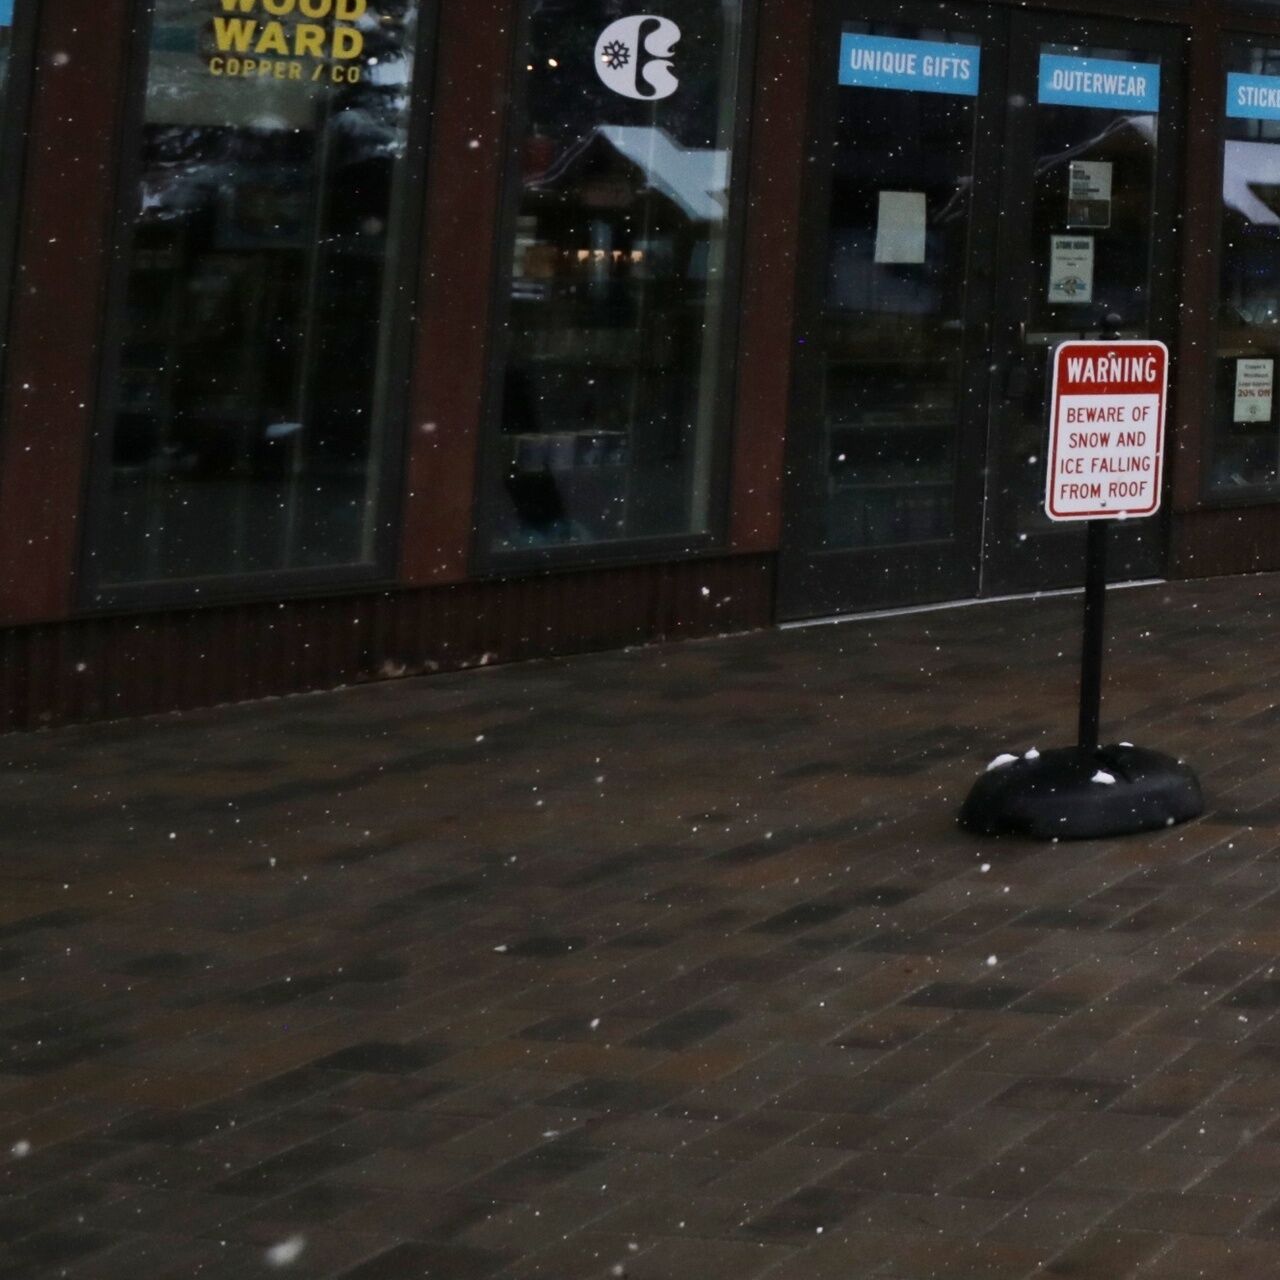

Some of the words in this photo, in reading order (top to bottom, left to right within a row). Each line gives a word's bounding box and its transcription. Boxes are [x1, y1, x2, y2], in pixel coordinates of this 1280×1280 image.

[213, 16, 364, 60] WARD
[208, 57, 302, 81] COPPER
[331, 65, 360, 83] CO
[850, 47, 917, 75] UNIQUE
[922, 56, 971, 80] GIFTS
[1052, 68, 1147, 97] OUTERWEAR
[1066, 357, 1157, 384] WARNING
[1066, 406, 1126, 423] BEWARE
[1131, 406, 1151, 422] OF
[1068, 432, 1110, 449] SNOW
[1115, 431, 1147, 447] AND
[1060, 458, 1085, 475] ICE
[1090, 455, 1151, 473] FALLING
[1059, 483, 1101, 500] FROM
[1107, 480, 1148, 497] ROOF
